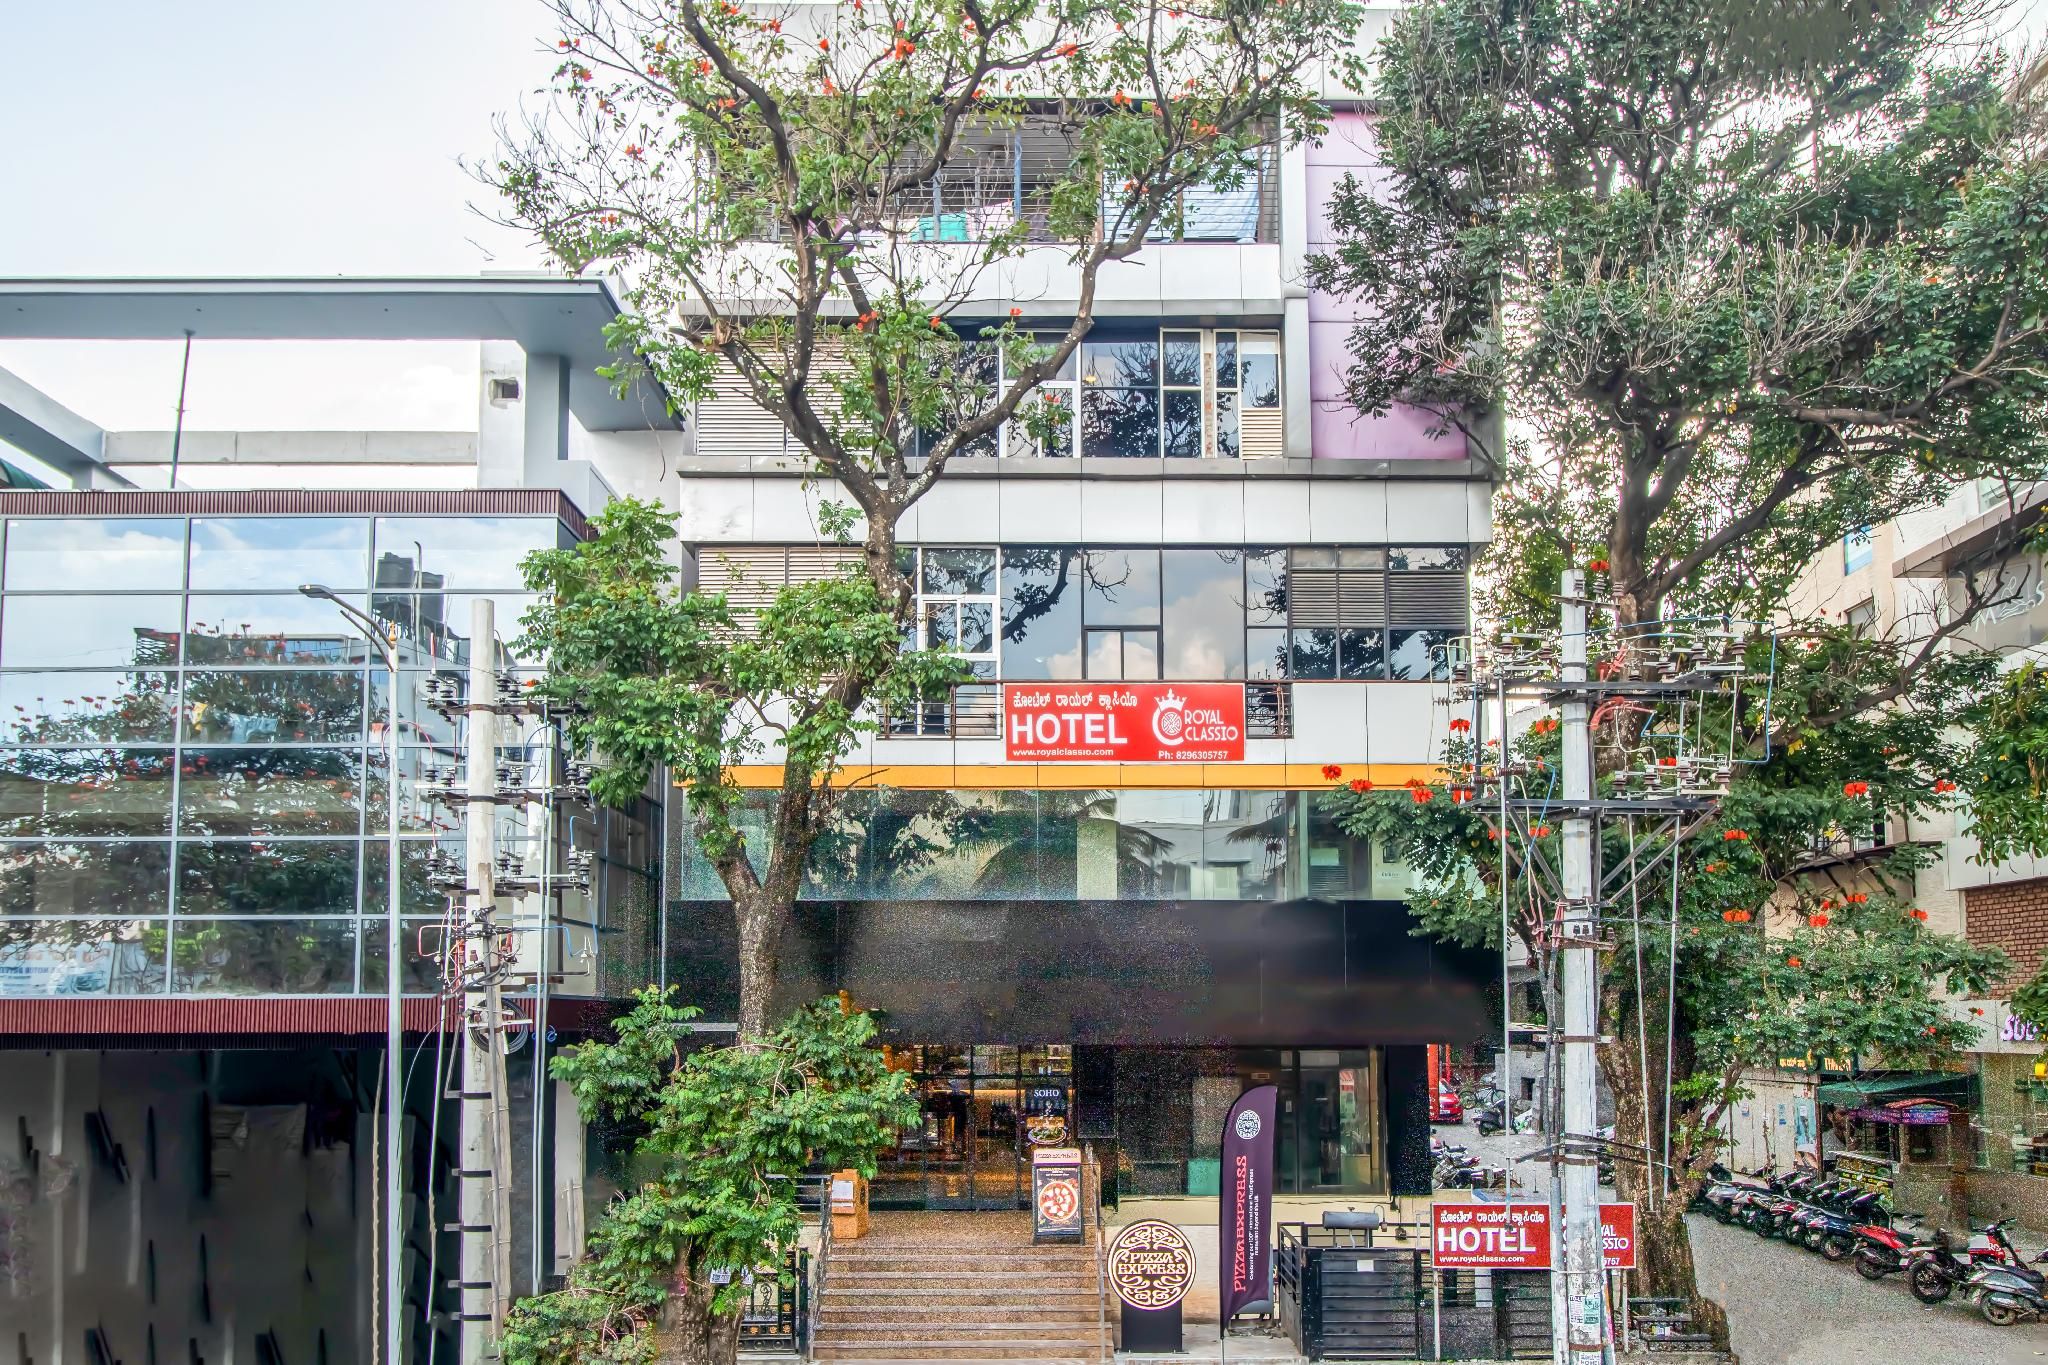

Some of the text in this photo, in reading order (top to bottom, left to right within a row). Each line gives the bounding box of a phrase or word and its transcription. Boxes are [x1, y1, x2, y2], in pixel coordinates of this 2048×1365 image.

[1184, 709, 1224, 725] ROYAL
[1011, 713, 1128, 744] HOTEL
[1185, 726, 1239, 741] CLASSIO
[1158, 751, 1228, 759] Ph: 8296305757
[1033, 1089, 1060, 1097] SOHO
[1437, 1227, 1537, 1252] HOTEL
[1129, 1252, 1174, 1263] PIZZA
[1117, 1263, 1186, 1275] EXPRESS
